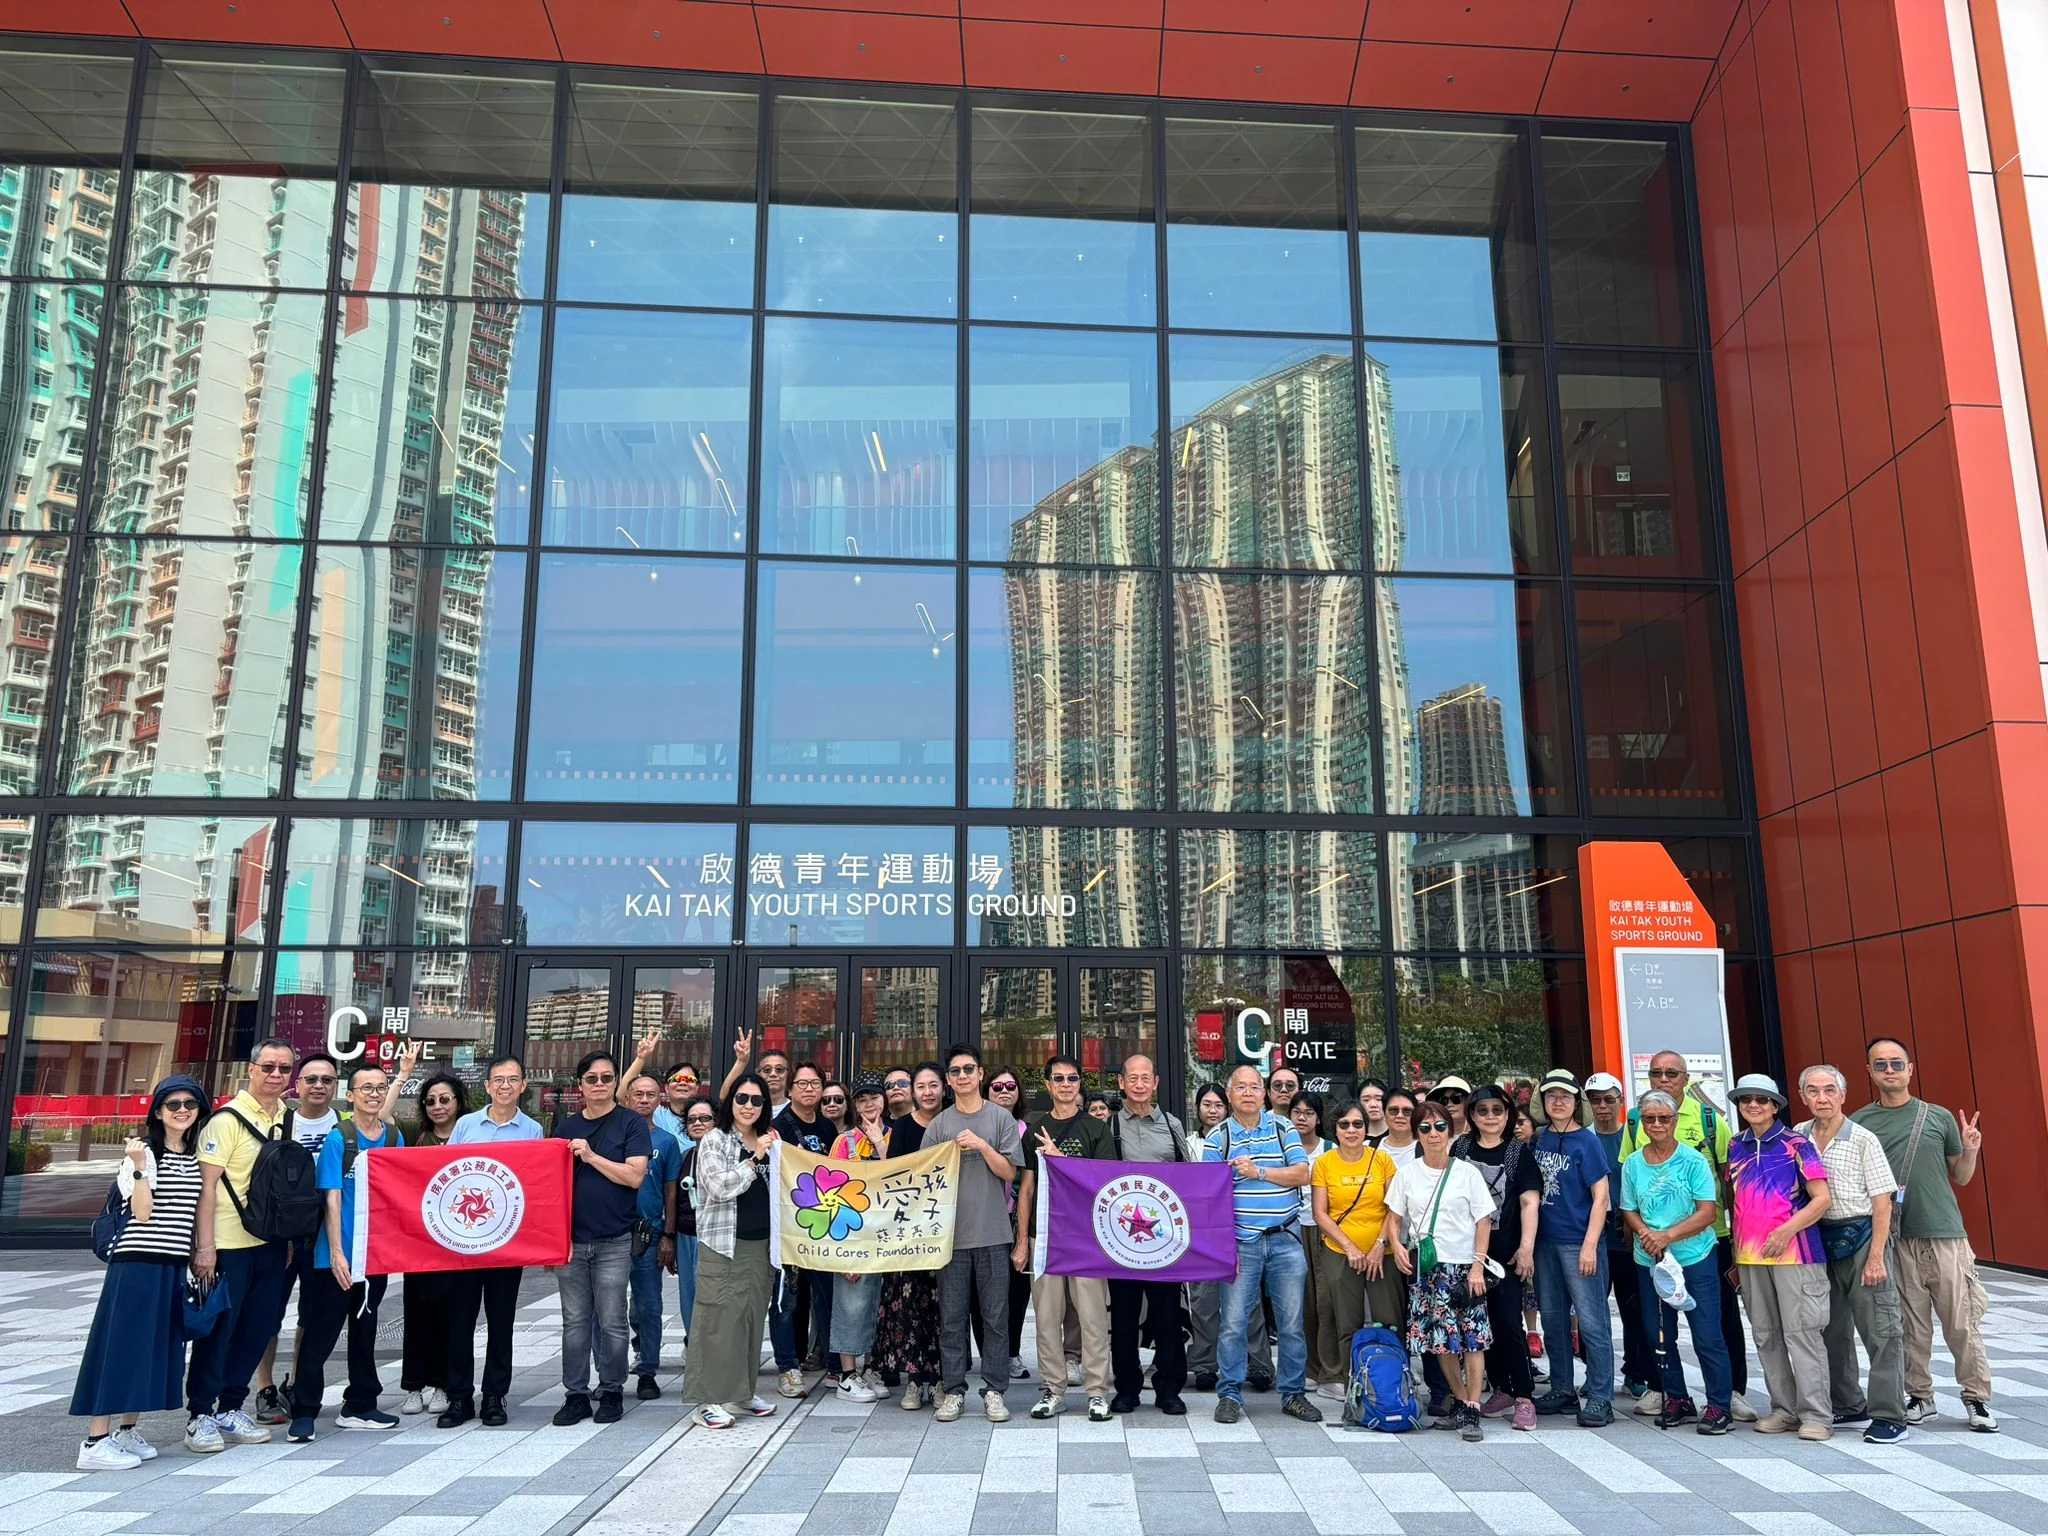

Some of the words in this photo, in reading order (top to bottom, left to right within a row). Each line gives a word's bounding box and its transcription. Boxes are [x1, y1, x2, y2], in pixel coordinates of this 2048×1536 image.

[699, 852, 1003, 886] 啟德青年運動場
[625, 893, 671, 917] KAI
[679, 893, 731, 917] TAK
[748, 893, 837, 917] YOUTH
[846, 893, 952, 917] SPORTS
[968, 893, 1076, 917] GROUND
[1609, 900, 1693, 912] 啟德青年運動場
[1610, 916, 1628, 926] KAI
[1632, 916, 1652, 926] TAK
[1655, 916, 1691, 926] YOUTH
[1611, 930, 1654, 941] SPORTS
[1657, 930, 1702, 941] GROUND
[327, 1006, 368, 1060] C
[381, 1007, 410, 1034] 閘
[1237, 1007, 1272, 1059] C
[1283, 1008, 1309, 1034] 閘
[1285, 1041, 1336, 1060] GATE
[430, 1160, 516, 1196] 房屋署公務員工會
[431, 1223, 452, 1245] SERVANTS
[452, 1241, 470, 1249] UNION
[479, 1235, 504, 1249] HOUSING
[502, 1204, 519, 1238] DEPARTMENT
[797, 1244, 830, 1257] Child
[835, 1248, 869, 1258] Cares
[876, 1244, 942, 1258] Foundation
